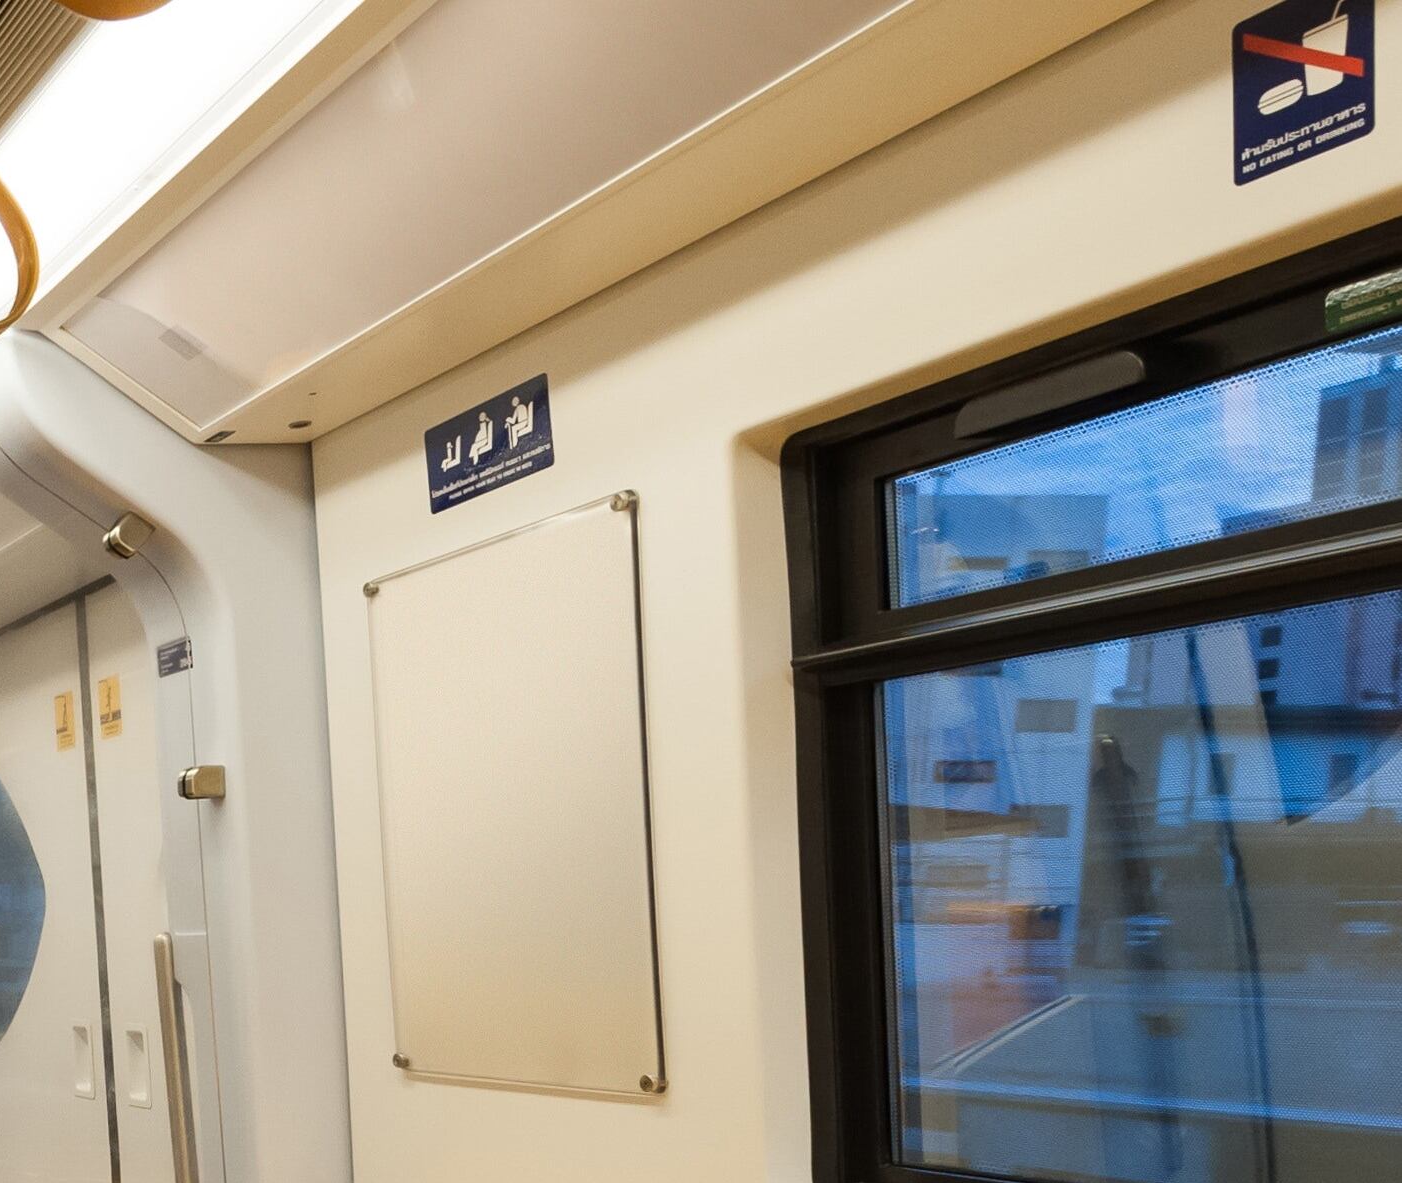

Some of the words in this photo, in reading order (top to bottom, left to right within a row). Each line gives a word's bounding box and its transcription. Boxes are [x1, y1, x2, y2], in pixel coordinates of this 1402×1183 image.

[1242, 162, 1257, 174] NO
[1259, 146, 1294, 167] EATING
[1297, 139, 1312, 152] OR
[1315, 118, 1366, 145] DRINKING
